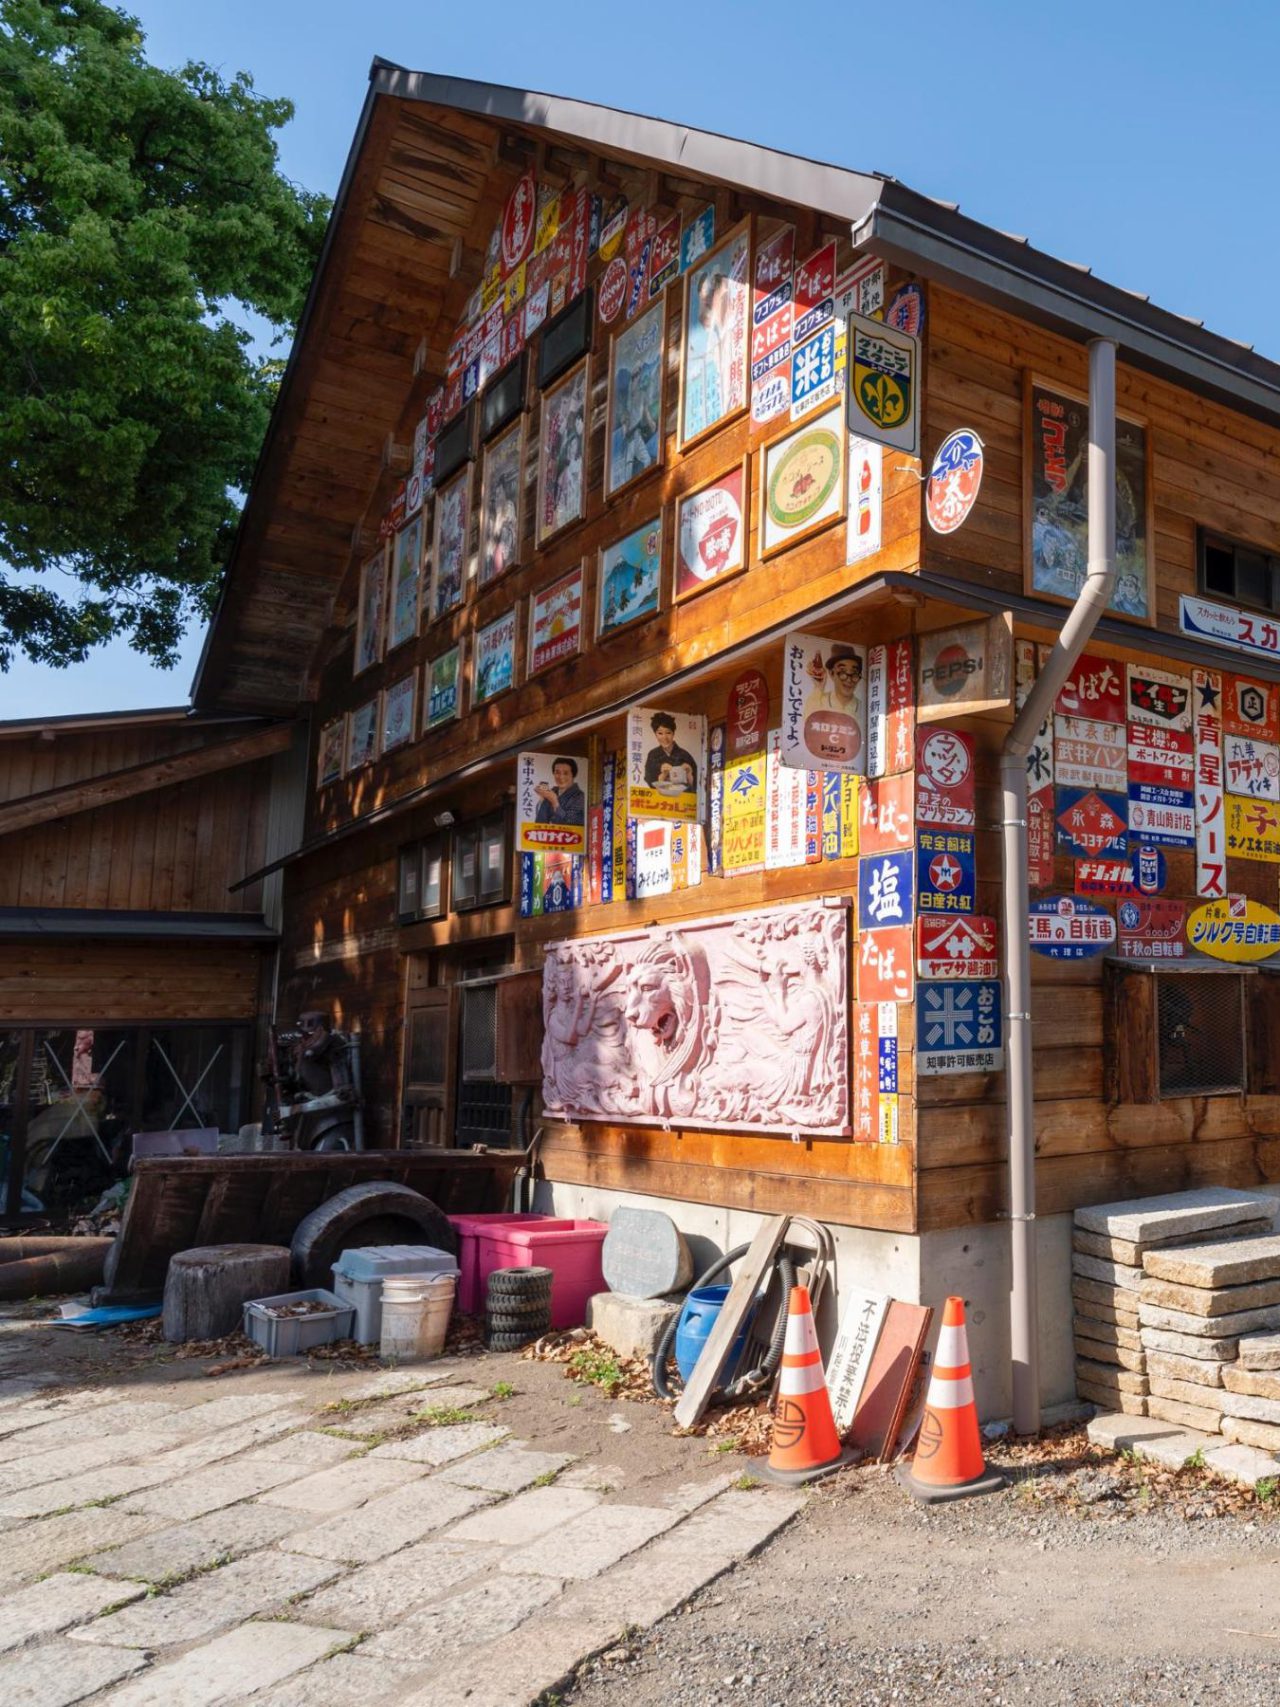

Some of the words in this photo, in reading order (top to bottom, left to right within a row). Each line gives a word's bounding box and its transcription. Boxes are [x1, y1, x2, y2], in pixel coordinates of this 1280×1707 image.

[757, 252, 791, 283] たばこ
[795, 267, 833, 298] たばこ
[753, 312, 790, 356] たばこ
[795, 342, 821, 398] 米
[936, 472, 972, 517] 茶
[921, 657, 984, 684] PEPSI
[736, 678, 760, 695] ラジオ
[738, 706, 759, 722] TEN
[809, 722, 857, 734] オロナミン
[1057, 741, 1126, 769] 武井パン
[1228, 758, 1264, 784] アテナ
[521, 756, 535, 818] 家中みんなで
[918, 792, 951, 806] 東芝の
[1247, 777, 1272, 794] インキ
[862, 791, 911, 842] たばこ
[1196, 714, 1224, 896] 青星ソース
[1146, 809, 1192, 831] 青山時計店
[919, 834, 972, 853] 完全飼料
[1078, 864, 1135, 883] ナショナル
[867, 859, 904, 922] 塩
[919, 892, 972, 910] 日産丸紅
[861, 933, 909, 998] たばこ
[928, 960, 992, 976] ヤマサ醤油
[924, 987, 974, 1046] 米
[976, 985, 995, 1043] おこめ
[926, 1053, 995, 1069] 知事許可販売店
